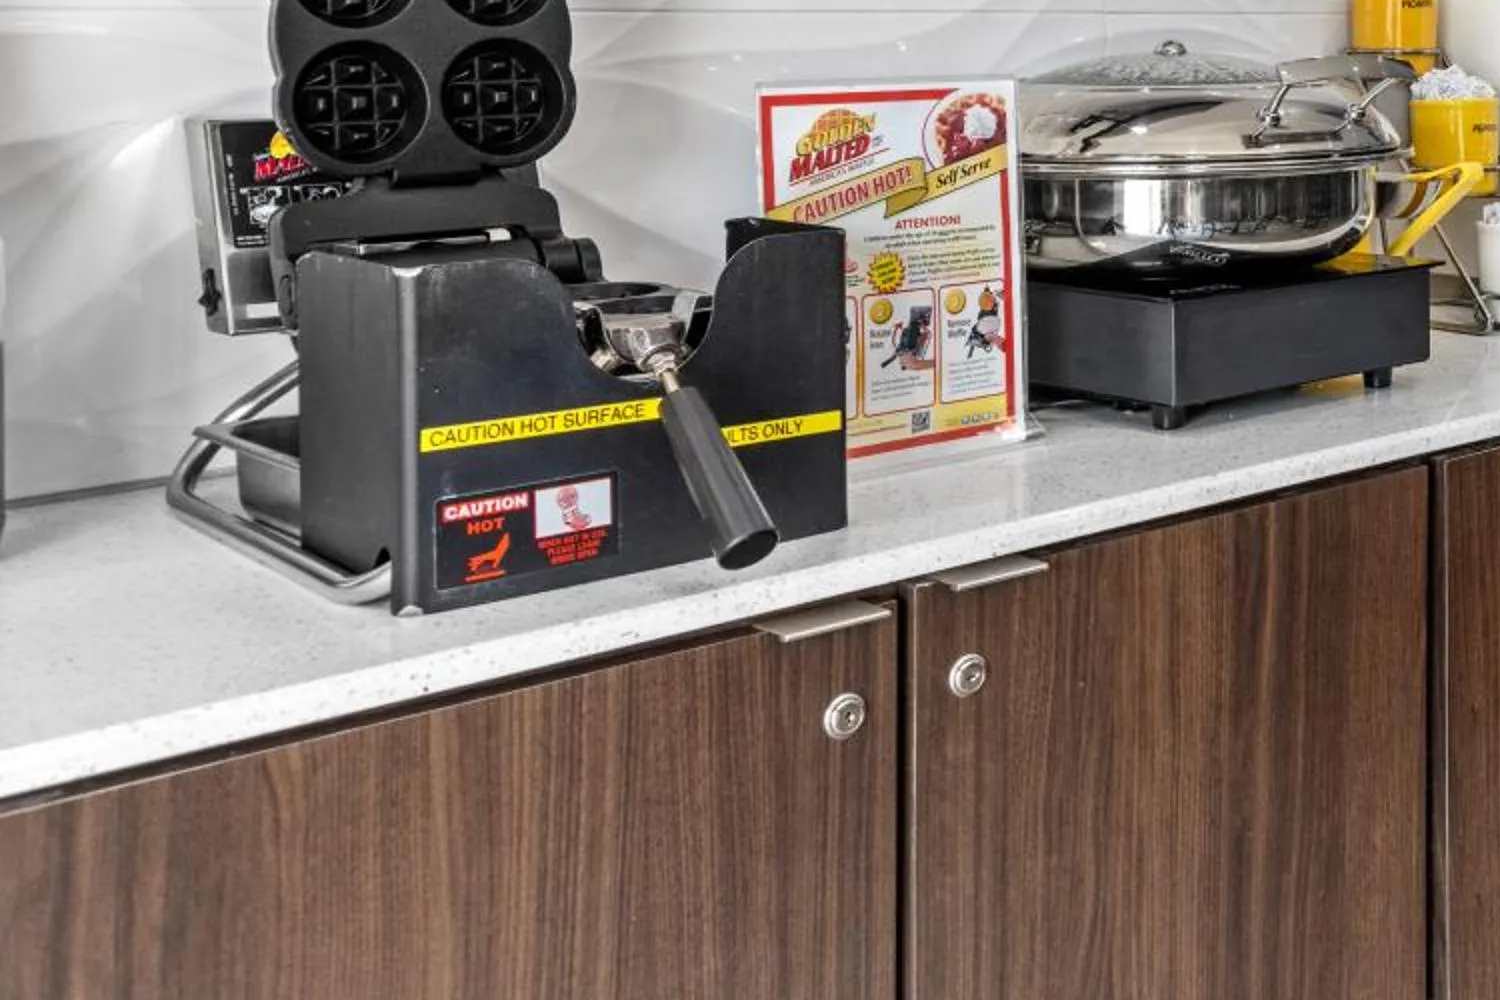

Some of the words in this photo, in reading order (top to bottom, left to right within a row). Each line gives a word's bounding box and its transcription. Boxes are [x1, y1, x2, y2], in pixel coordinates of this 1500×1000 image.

[796, 111, 878, 157] GOLDEN
[789, 133, 873, 182] MALTED
[935, 169, 958, 190] Self
[961, 157, 992, 178] Serve
[794, 180, 870, 222] CAUTION
[873, 165, 912, 196] HOT!
[895, 215, 961, 230] ATTENTION!
[429, 421, 515, 448] CAUTION
[519, 414, 558, 436] HOT
[563, 403, 646, 429] SURFACE
[762, 419, 804, 438] ONLY
[443, 491, 529, 522] CAUTION
[467, 517, 506, 535] HOT
